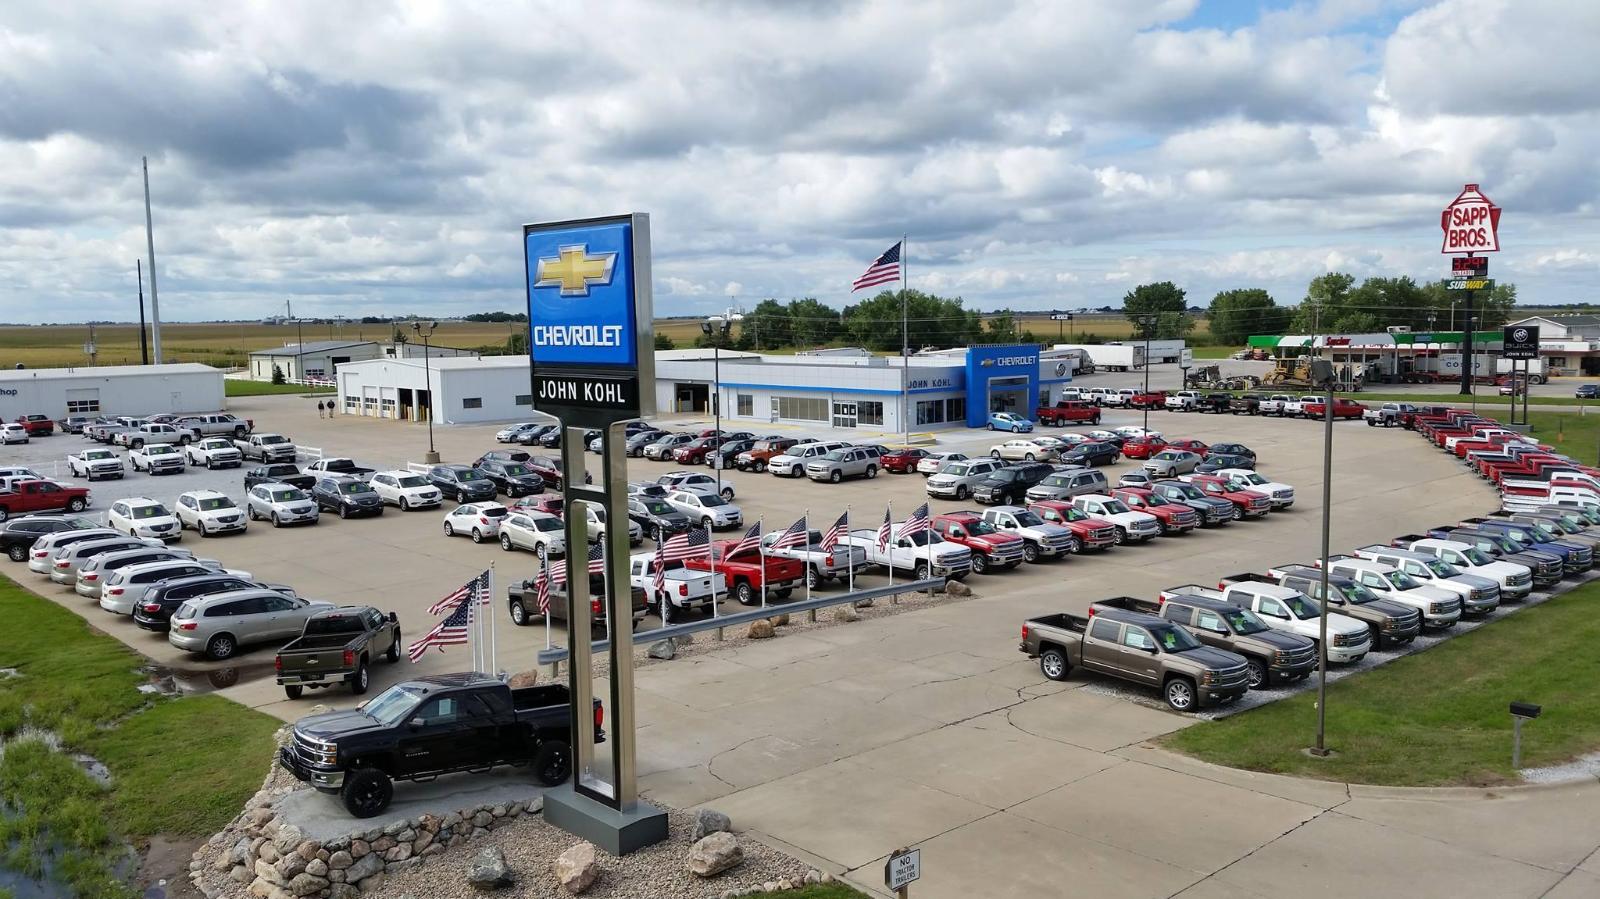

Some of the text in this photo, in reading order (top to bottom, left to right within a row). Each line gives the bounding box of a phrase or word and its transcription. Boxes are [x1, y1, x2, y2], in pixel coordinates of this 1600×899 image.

[1453, 206, 1488, 227] SAPP
[1449, 228, 1491, 248] BROS.
[1447, 280, 1489, 290] SUBWAY
[534, 325, 623, 347] CHEVROLET
[997, 355, 1037, 367] CHEVROLET
[907, 378, 952, 389] JOHN KOHL
[0, 388, 18, 397] hop
[539, 379, 626, 403] JOHN KOHL
[899, 856, 911, 867] NO
